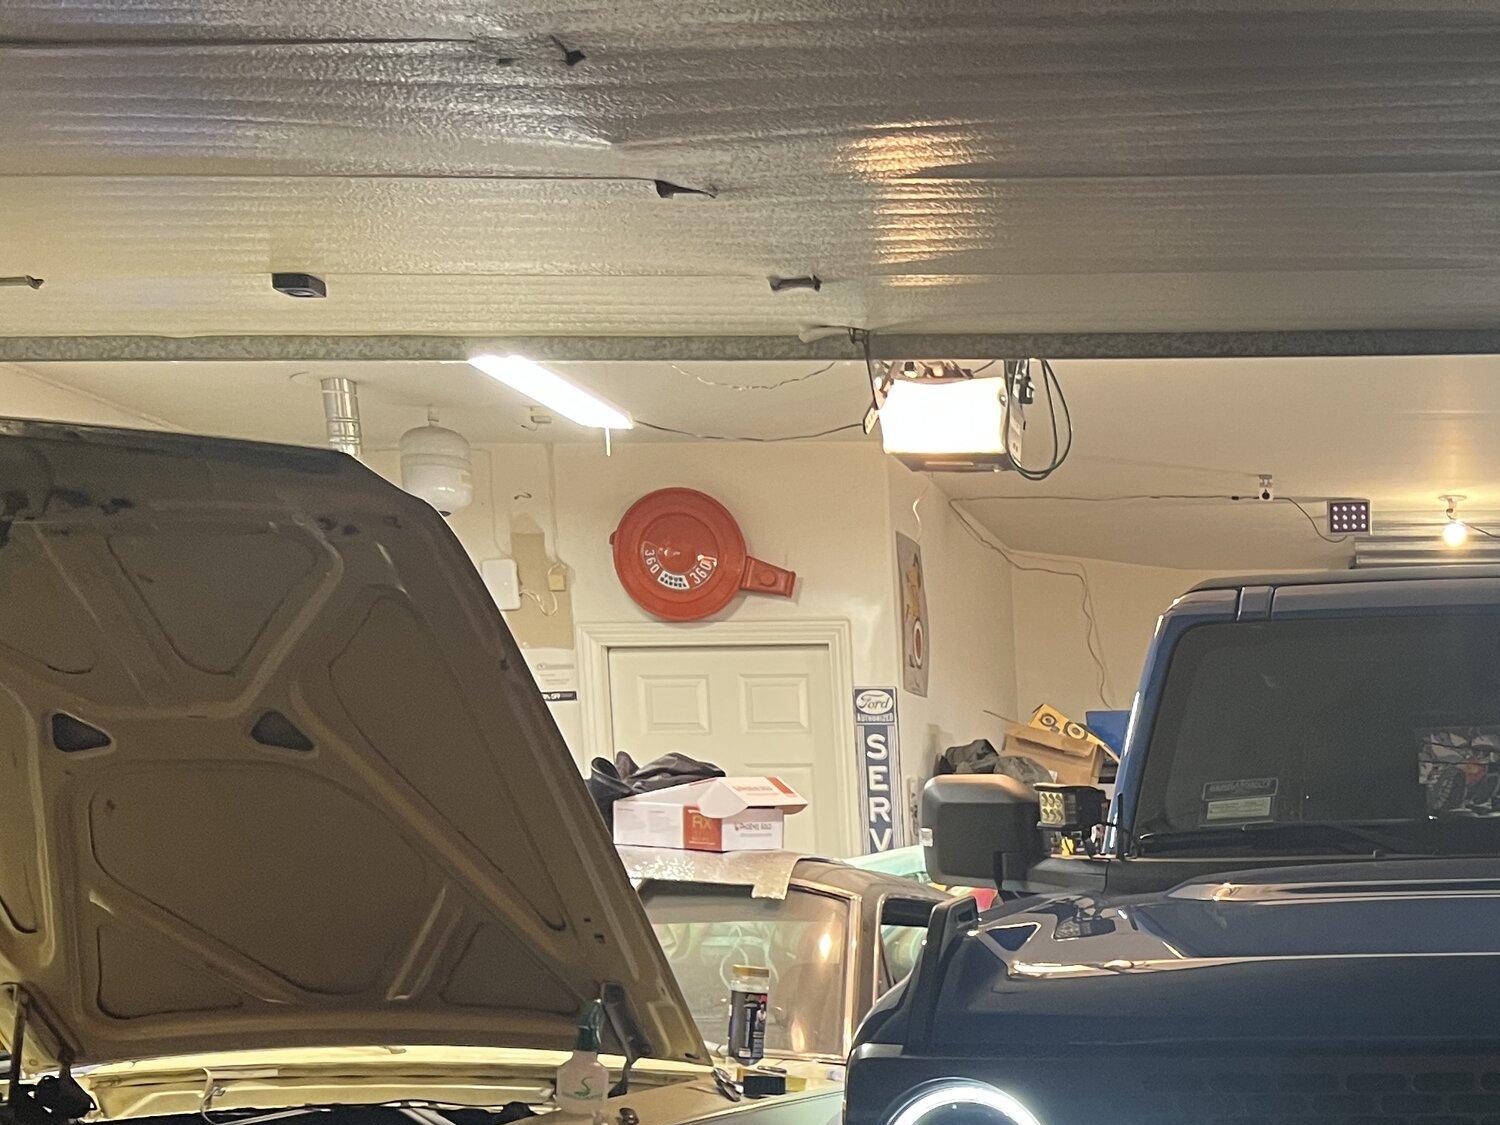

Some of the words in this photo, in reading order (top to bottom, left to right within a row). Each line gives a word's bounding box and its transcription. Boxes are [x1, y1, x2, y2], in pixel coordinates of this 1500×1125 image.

[644, 549, 660, 575] 360
[689, 560, 713, 584] 360
[858, 694, 891, 710] Ford
[866, 733, 893, 852] SERV
